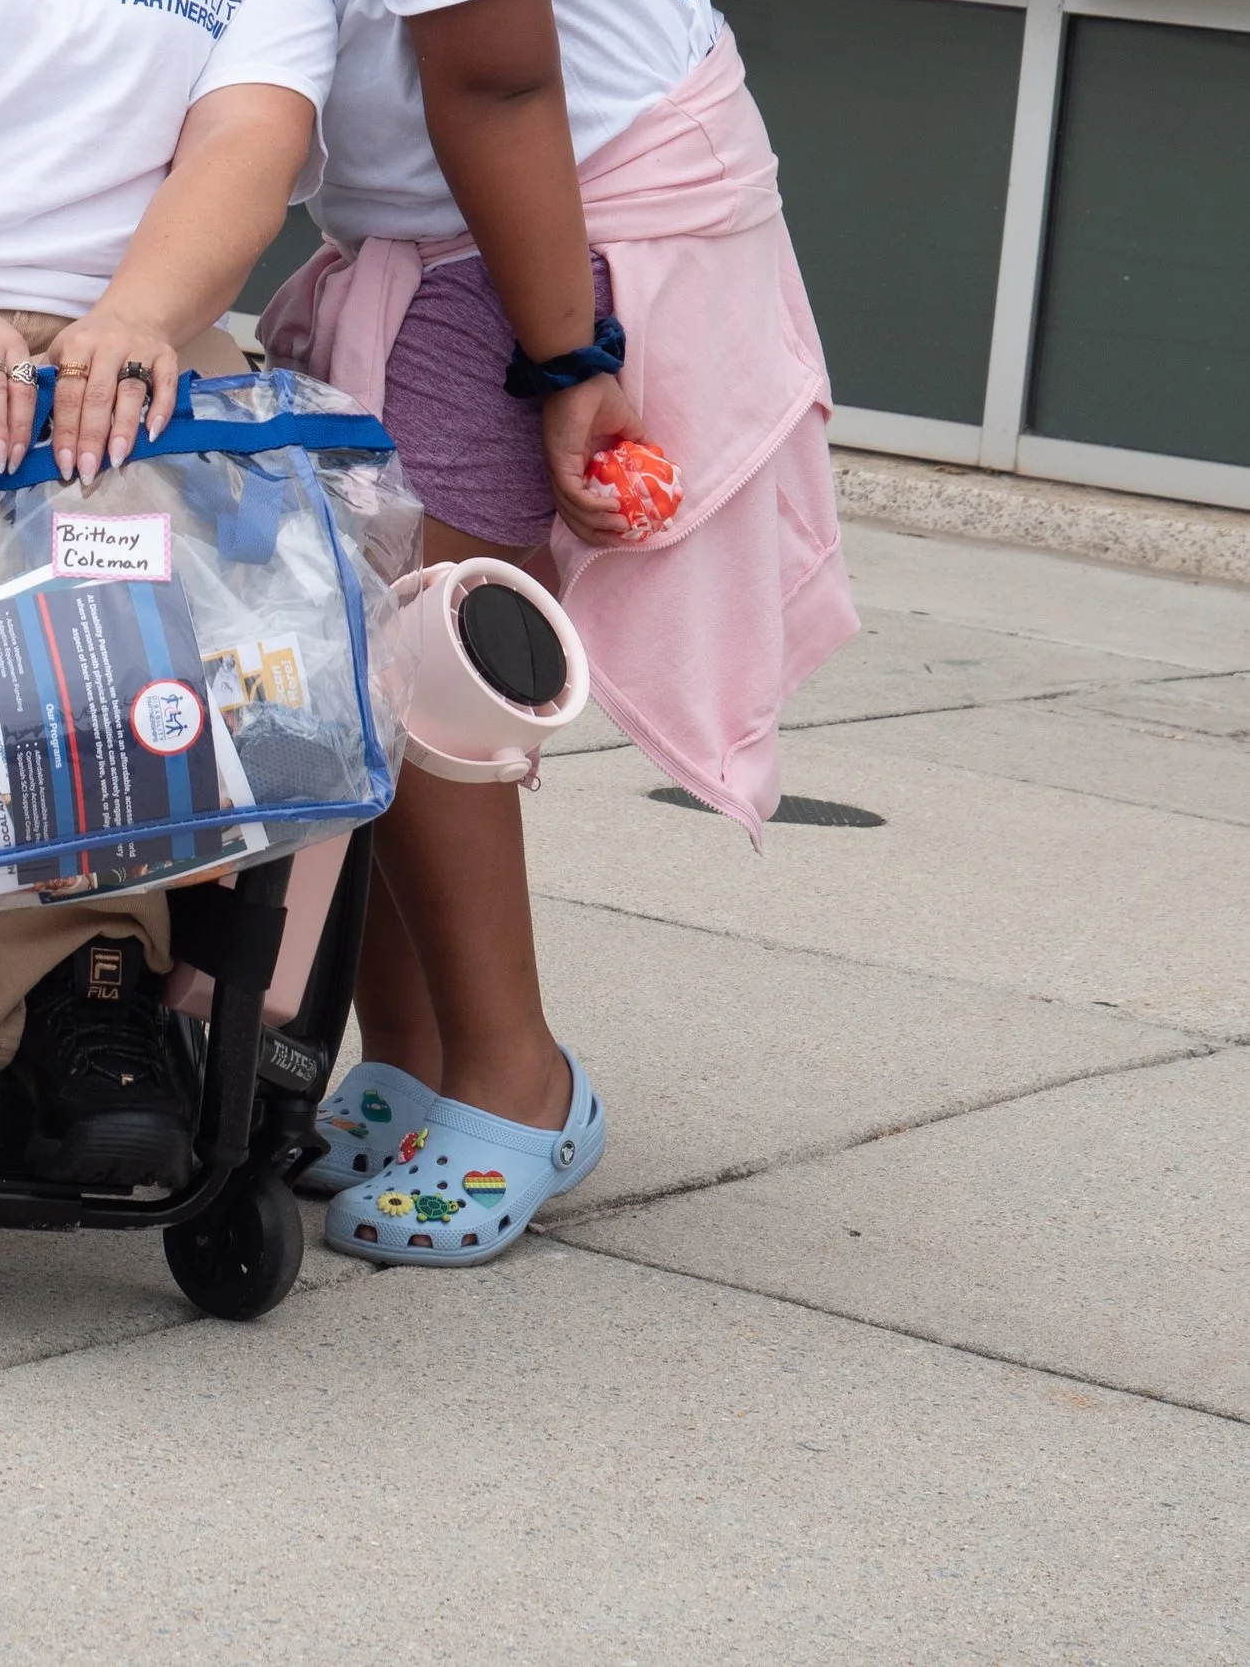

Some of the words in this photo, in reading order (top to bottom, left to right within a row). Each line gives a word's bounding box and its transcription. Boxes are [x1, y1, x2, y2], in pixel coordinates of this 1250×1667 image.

[56, 524, 141, 551] Brittany
[63, 548, 149, 571] Coleman
[76, 597, 86, 620] where
[86, 594, 94, 602] At
[88, 603, 103, 637] Disability
[6, 617, 17, 645] Adaptive
[13, 645, 24, 674] Wellness
[71, 627, 83, 652] aspect
[81, 621, 94, 651] persons
[78, 653, 86, 662] of
[89, 652, 100, 668] with
[4, 647, 17, 682] Equipment
[13, 683, 23, 712] Funding
[80, 662, 90, 681] their
[84, 681, 94, 701] lives
[92, 670, 107, 703] physical
[108, 685, 116, 698] we
[45, 703, 55, 721] Our
[88, 702, 101, 739] wherever
[111, 699, 122, 728] believe
[100, 704, 114, 748] disabilities
[117, 730, 123, 738] in
[48, 722, 62, 768] Programs
[94, 741, 103, 759] they
[118, 739, 124, 750] an
[15, 752, 25, 780] Spanish
[25, 750, 36, 791] Community
[33, 749, 44, 786] Affordable
[97, 760, 106, 777] live,
[120, 751, 131, 794] affordable,
[100, 779, 108, 801] work,
[110, 766, 120, 797] actively
[20, 793, 30, 819] Support
[30, 792, 40, 832] Accessibility
[38, 786, 48, 820] Accessible
[102, 802, 108, 811] or
[111, 798, 121, 826] engage
[24, 820, 32, 841] Group
[127, 841, 136, 857] orld
[87, 985, 119, 999] FILA
